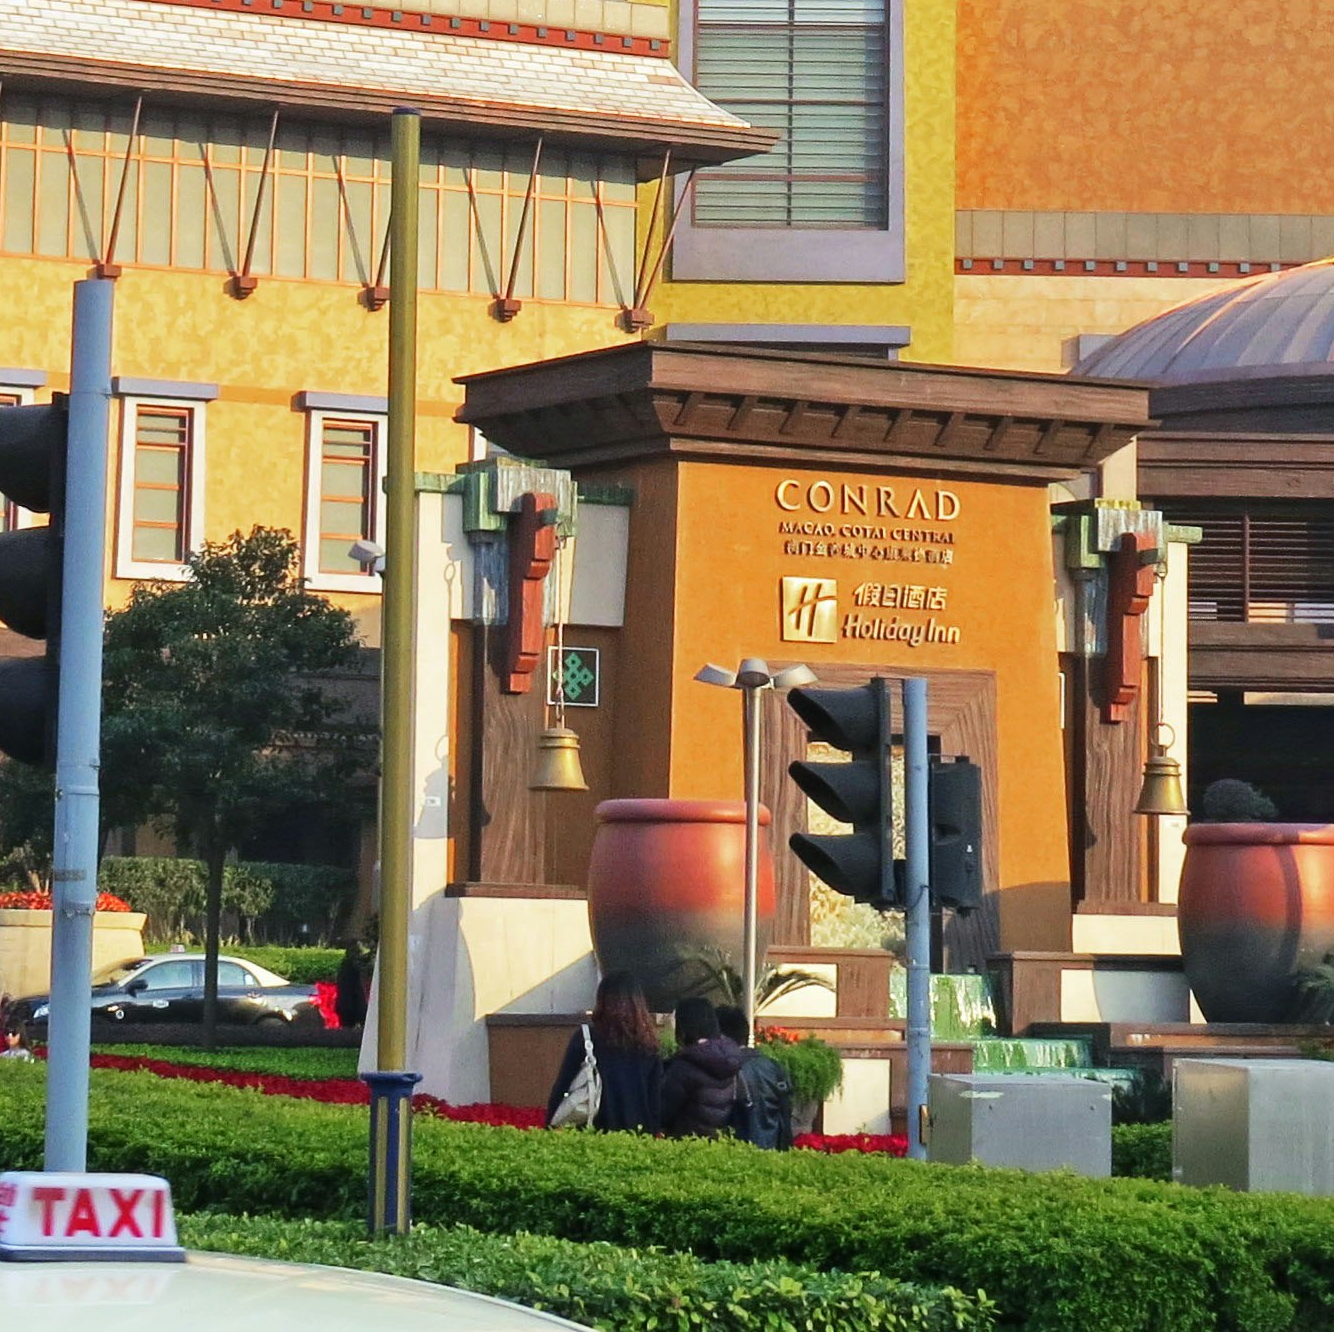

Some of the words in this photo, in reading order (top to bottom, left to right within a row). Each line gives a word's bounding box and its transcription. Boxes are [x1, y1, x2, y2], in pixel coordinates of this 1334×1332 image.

[775, 479, 961, 521] CONRAD
[839, 523, 886, 540] COTAI
[852, 582, 948, 610] 假日酒店
[842, 613, 926, 647] Holiday
[927, 618, 961, 644] Inn
[32, 1186, 165, 1238] TAXI
